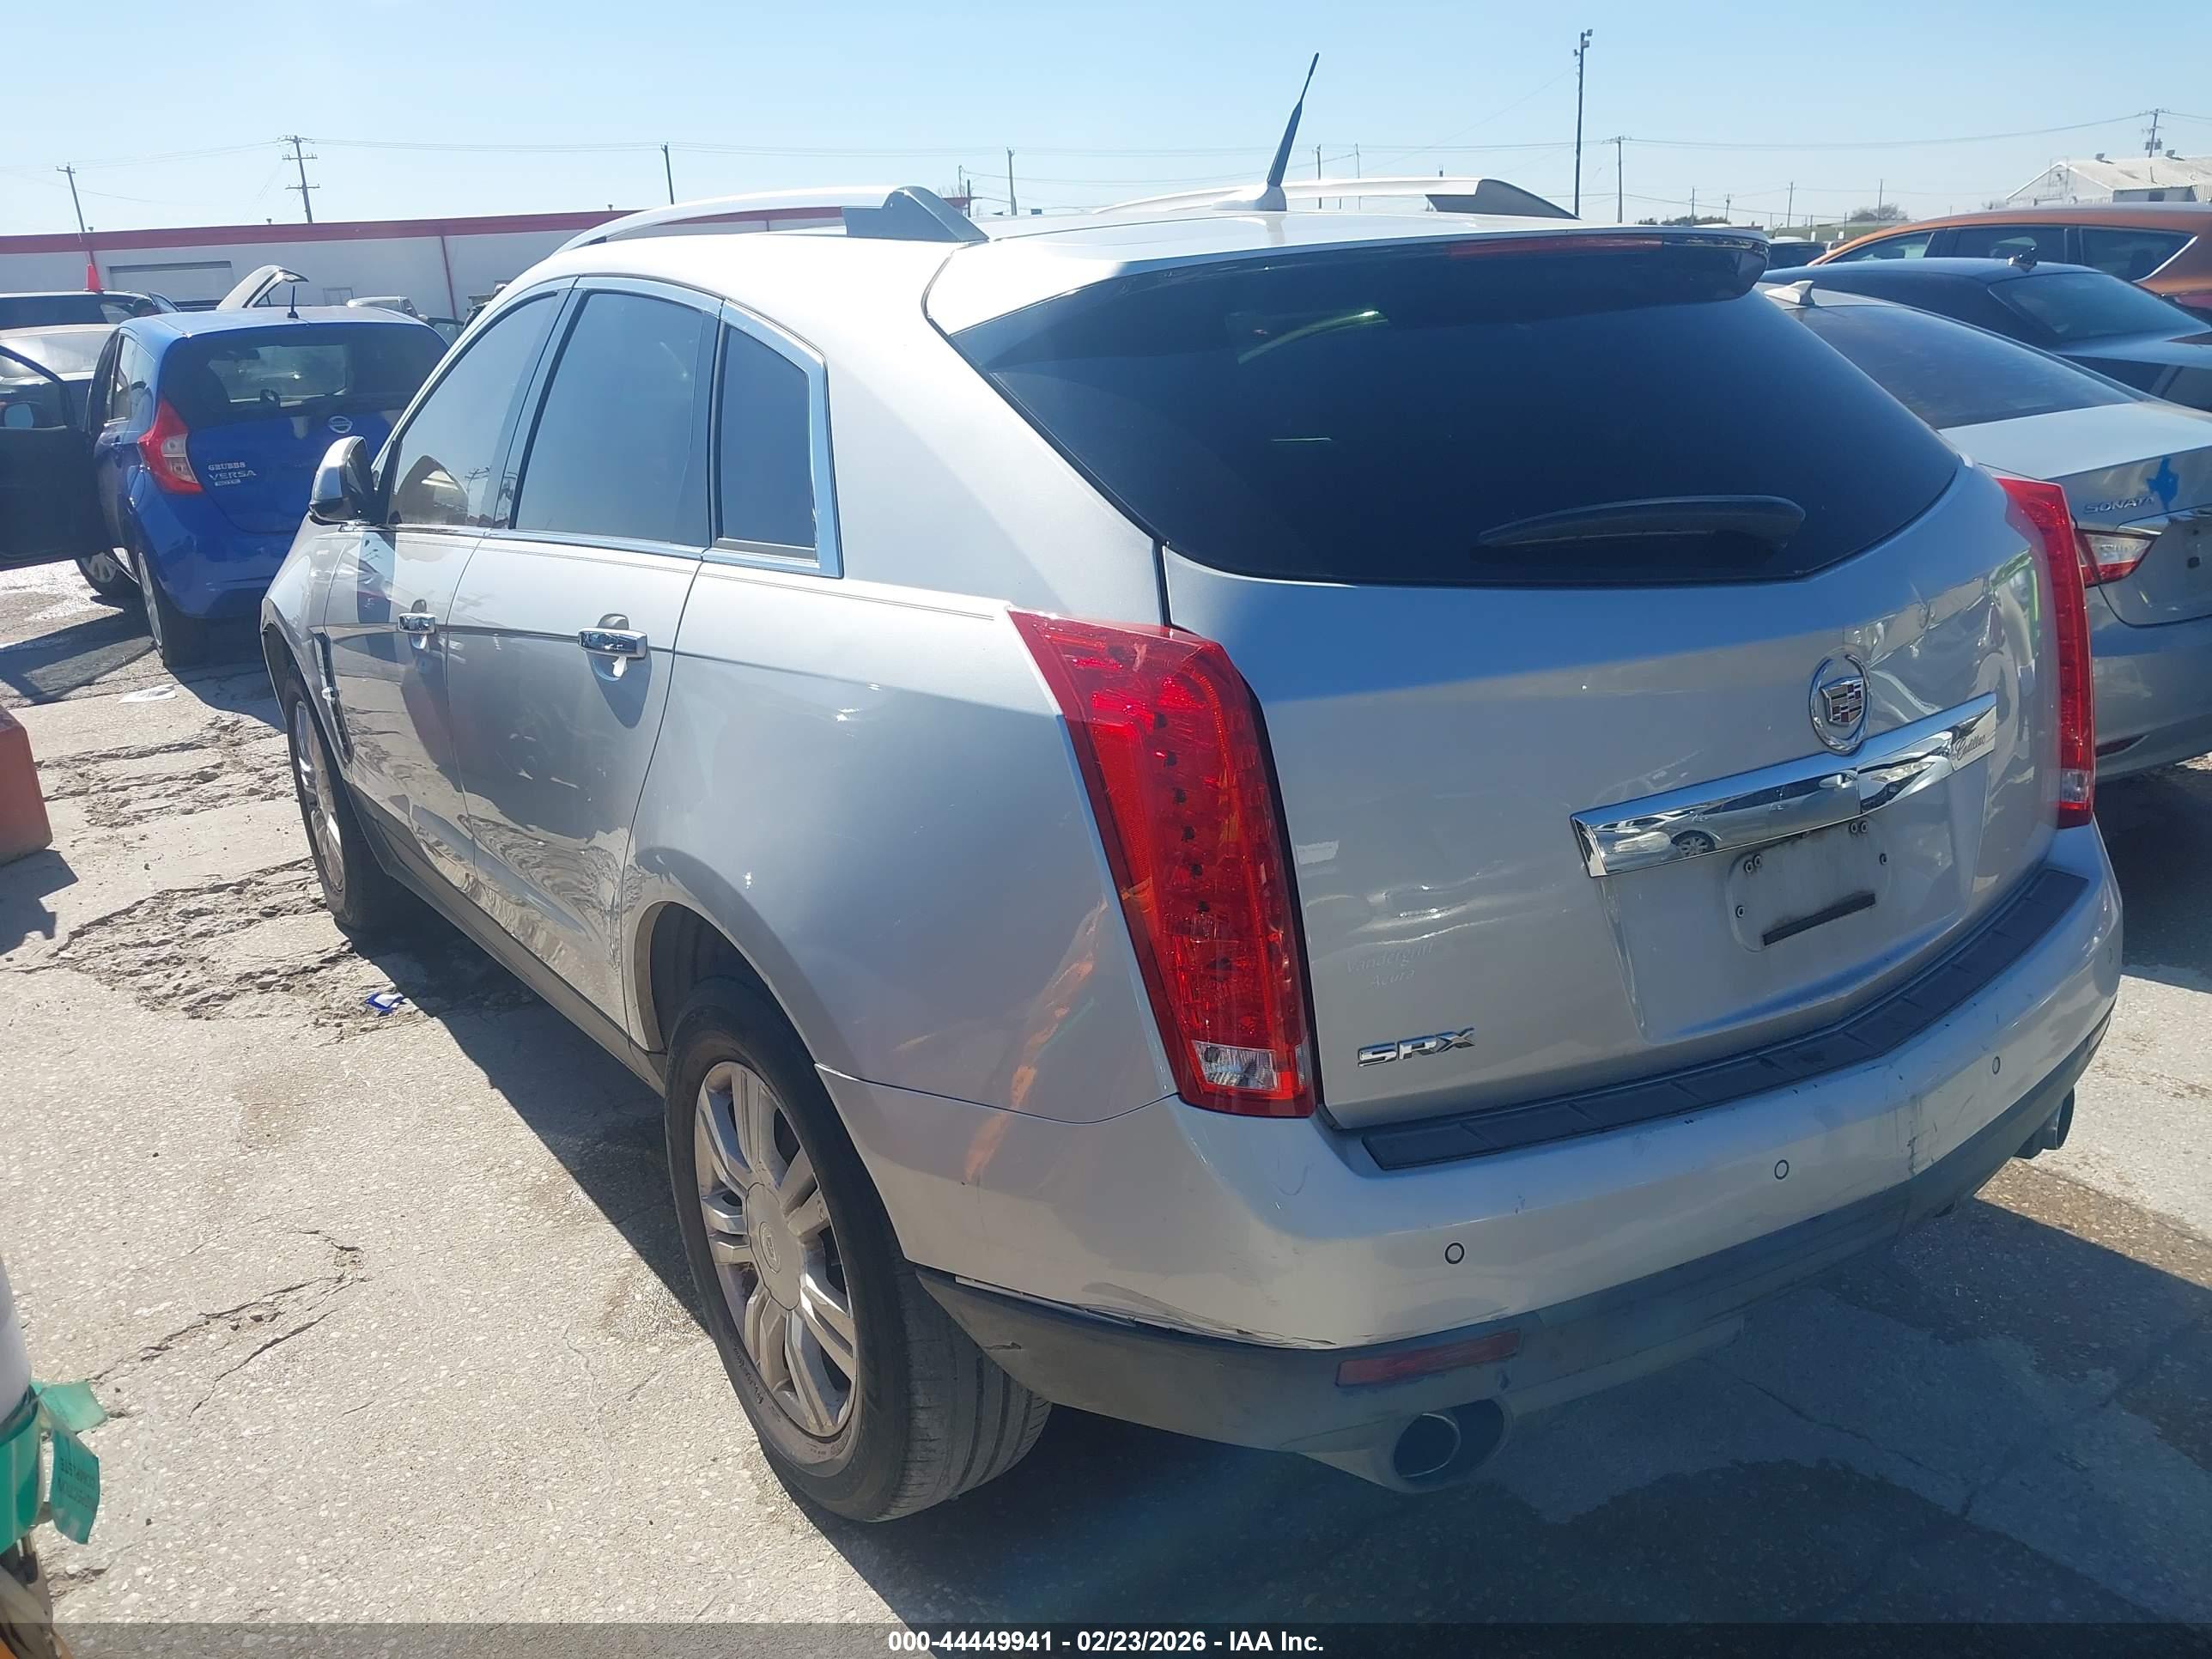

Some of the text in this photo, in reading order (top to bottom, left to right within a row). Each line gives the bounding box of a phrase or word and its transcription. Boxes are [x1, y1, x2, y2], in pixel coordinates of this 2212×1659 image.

[209, 470, 258, 481] VERSA
[2084, 496, 2154, 514] SONATA
[1954, 734, 1986, 761] Cadillac
[1358, 1027, 1475, 1066] SRX
